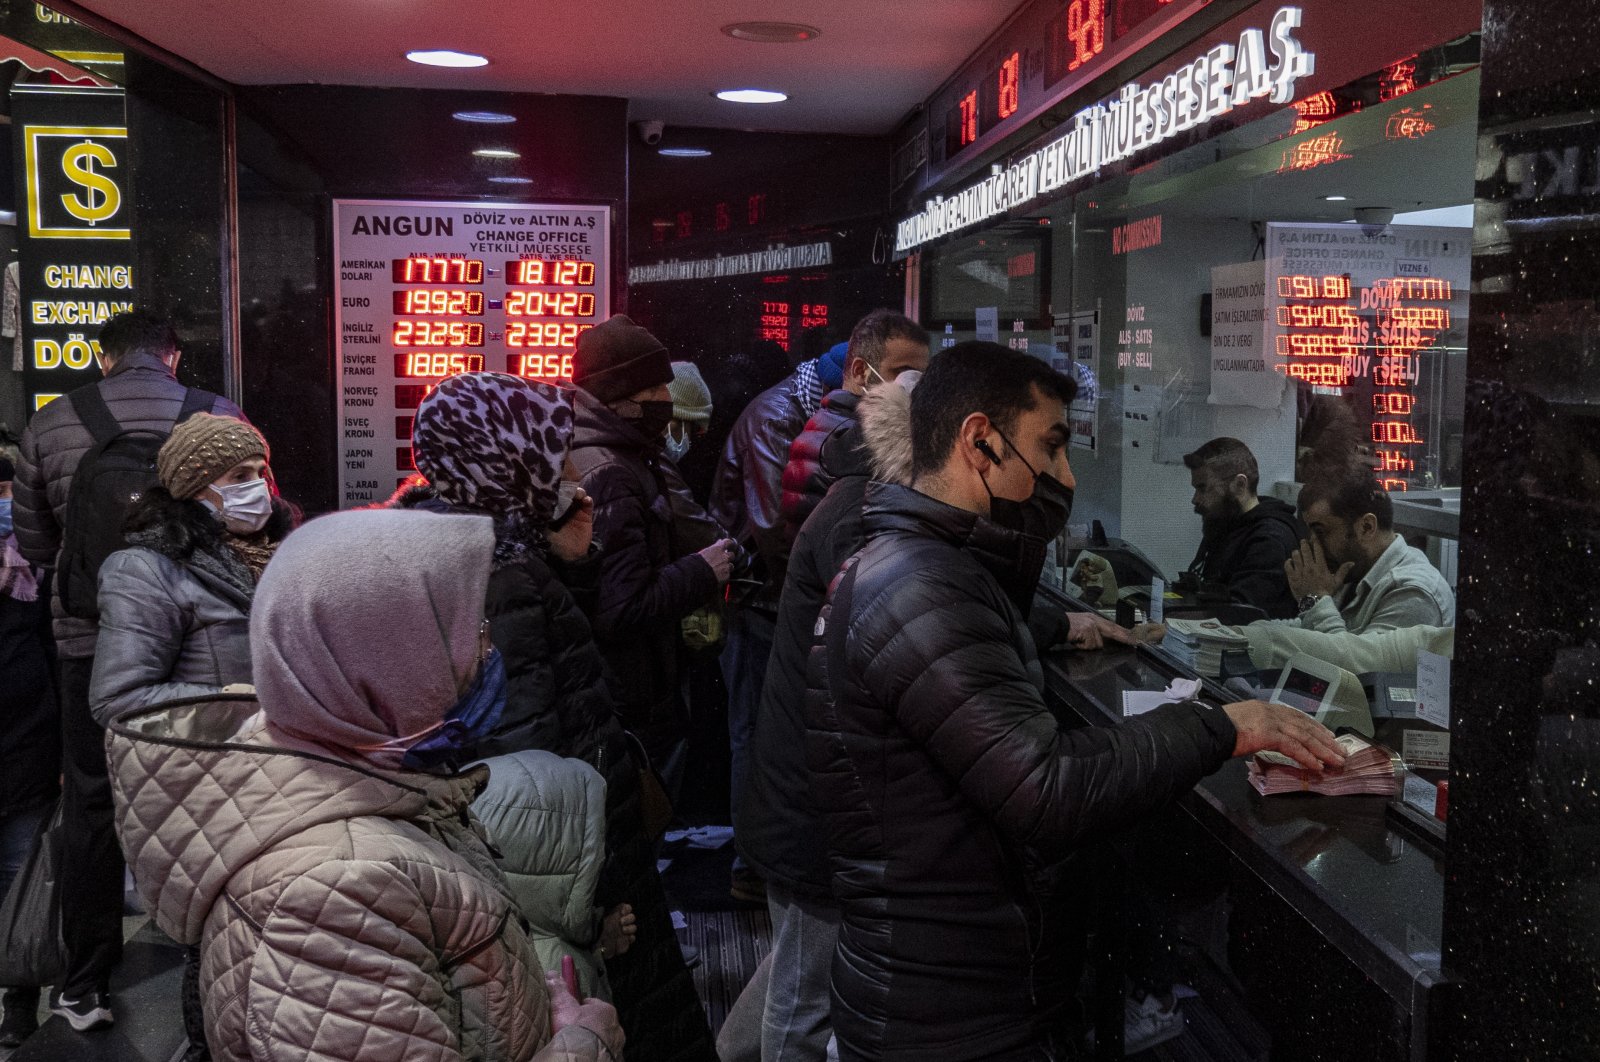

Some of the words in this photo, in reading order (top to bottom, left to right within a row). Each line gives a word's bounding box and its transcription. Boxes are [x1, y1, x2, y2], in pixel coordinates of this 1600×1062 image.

[956, 182, 989, 229] ALTIN
[986, 154, 1037, 214] TİCARET
[1036, 106, 1101, 193] YETKİLİ
[1100, 45, 1234, 164] MÜESSESE
[463, 211, 506, 225] DÖVİZ
[510, 216, 526, 225] ve
[529, 214, 570, 227] ALTIN
[352, 215, 453, 237] ANGUN
[476, 230, 536, 242] CHANGE
[538, 231, 588, 243] OFFICE
[470, 241, 521, 253] YETKİLİ
[523, 242, 592, 255] MÜESSESE
[341, 259, 385, 269] AMERİKAN
[1399, 263, 1422, 273] VEZNE
[1423, 263, 1429, 273] 6
[45, 265, 132, 289] CHANG
[341, 272, 373, 281] DOLARI
[342, 297, 370, 307] EURO
[32, 301, 133, 324] EXCHAN
[343, 322, 374, 332] İNGİLİZ
[343, 334, 381, 344] STERLİNİ
[508, 322, 593, 347] 23.92
[1118, 330, 1131, 348] ALIŞ
[1135, 329, 1153, 348] SATIŞ
[1342, 321, 1370, 349] ALIŞ
[344, 354, 376, 365] İSVİÇRE
[1117, 352, 1131, 369] (BUY
[1136, 352, 1152, 371] SELL)
[344, 367, 375, 376] FRANGI
[344, 387, 378, 396] NORVEÇ
[344, 399, 374, 407] KRONU
[345, 418, 369, 427] İSVEÇ
[345, 430, 375, 438] KRONU
[345, 450, 373, 458] JAPON
[346, 460, 365, 469] YENİ
[355, 480, 378, 489] ARAB
[346, 491, 372, 500] RİYALİ
